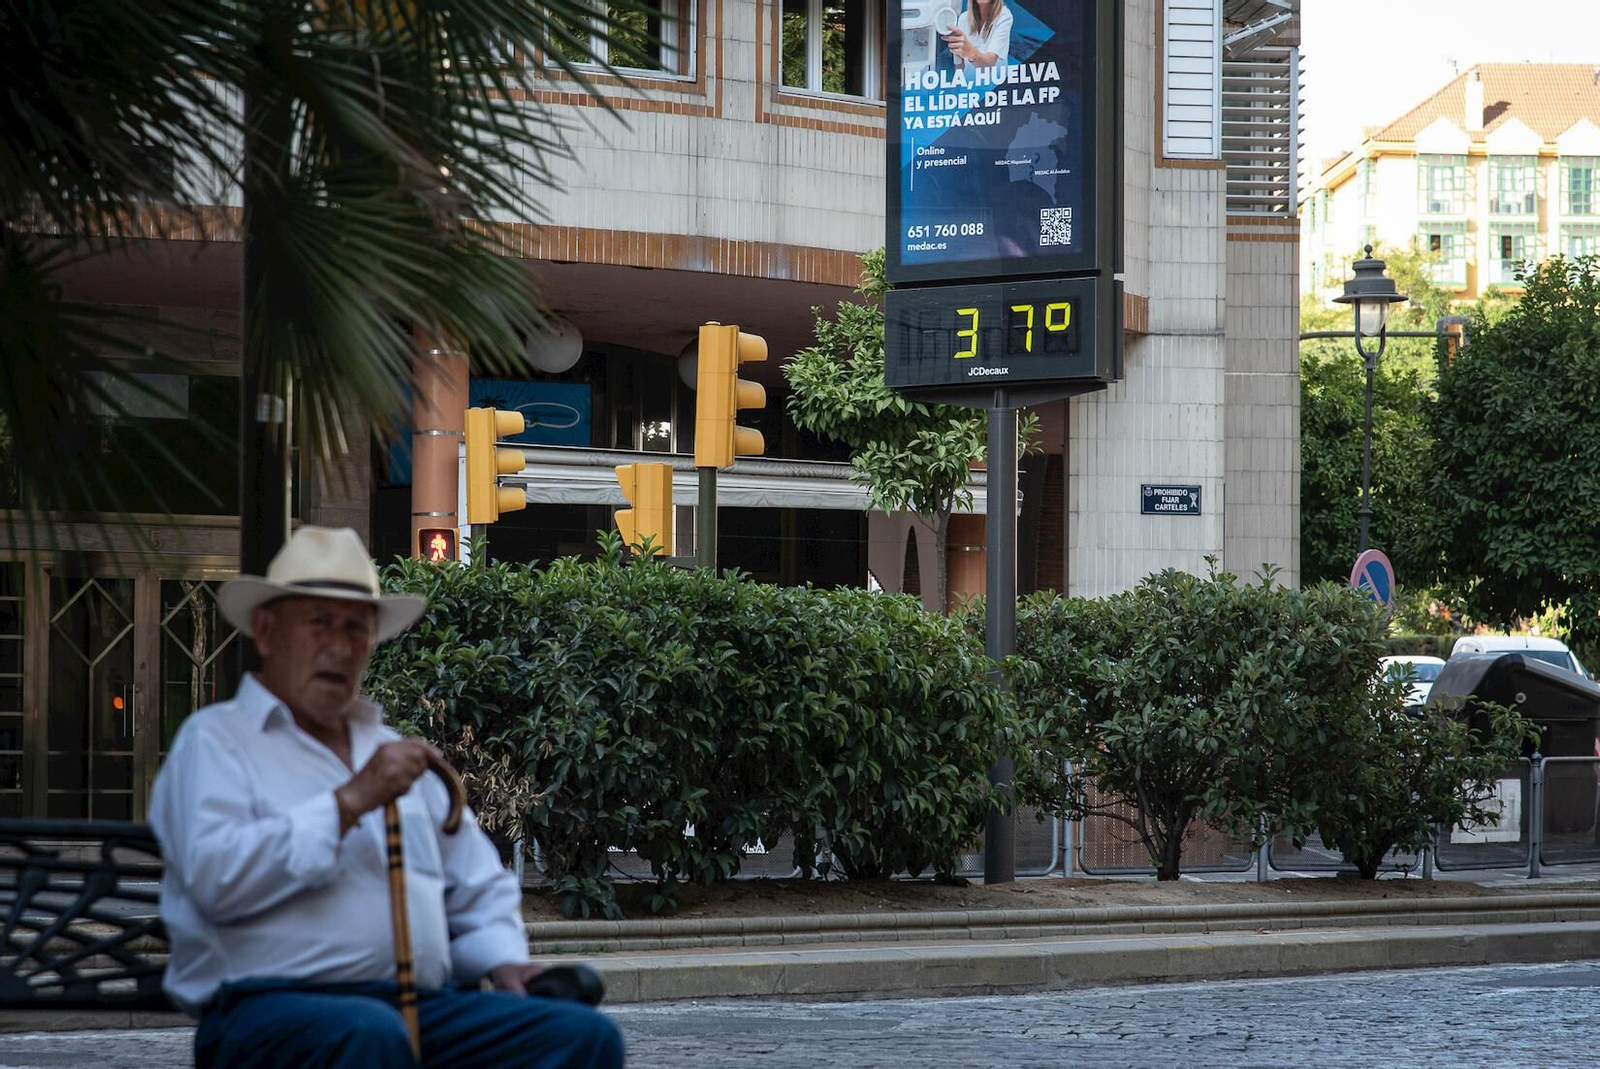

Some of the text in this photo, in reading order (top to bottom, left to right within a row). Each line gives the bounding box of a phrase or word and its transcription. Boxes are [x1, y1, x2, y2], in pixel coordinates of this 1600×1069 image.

[975, 61, 1061, 86] HUELVA
[904, 86, 1060, 112] EL LÍDER DE LA FP
[903, 108, 1002, 130] YA ESTÁ AQUÍ
[916, 146, 945, 156] Online
[916, 155, 967, 169] y presencial
[907, 222, 984, 239] 651 760 088
[907, 241, 947, 251] medac.es
[968, 366, 1009, 376] JCDecaux
[1153, 488, 1188, 496] PROHIBIDO
[1154, 503, 1188, 511] CARTELES
